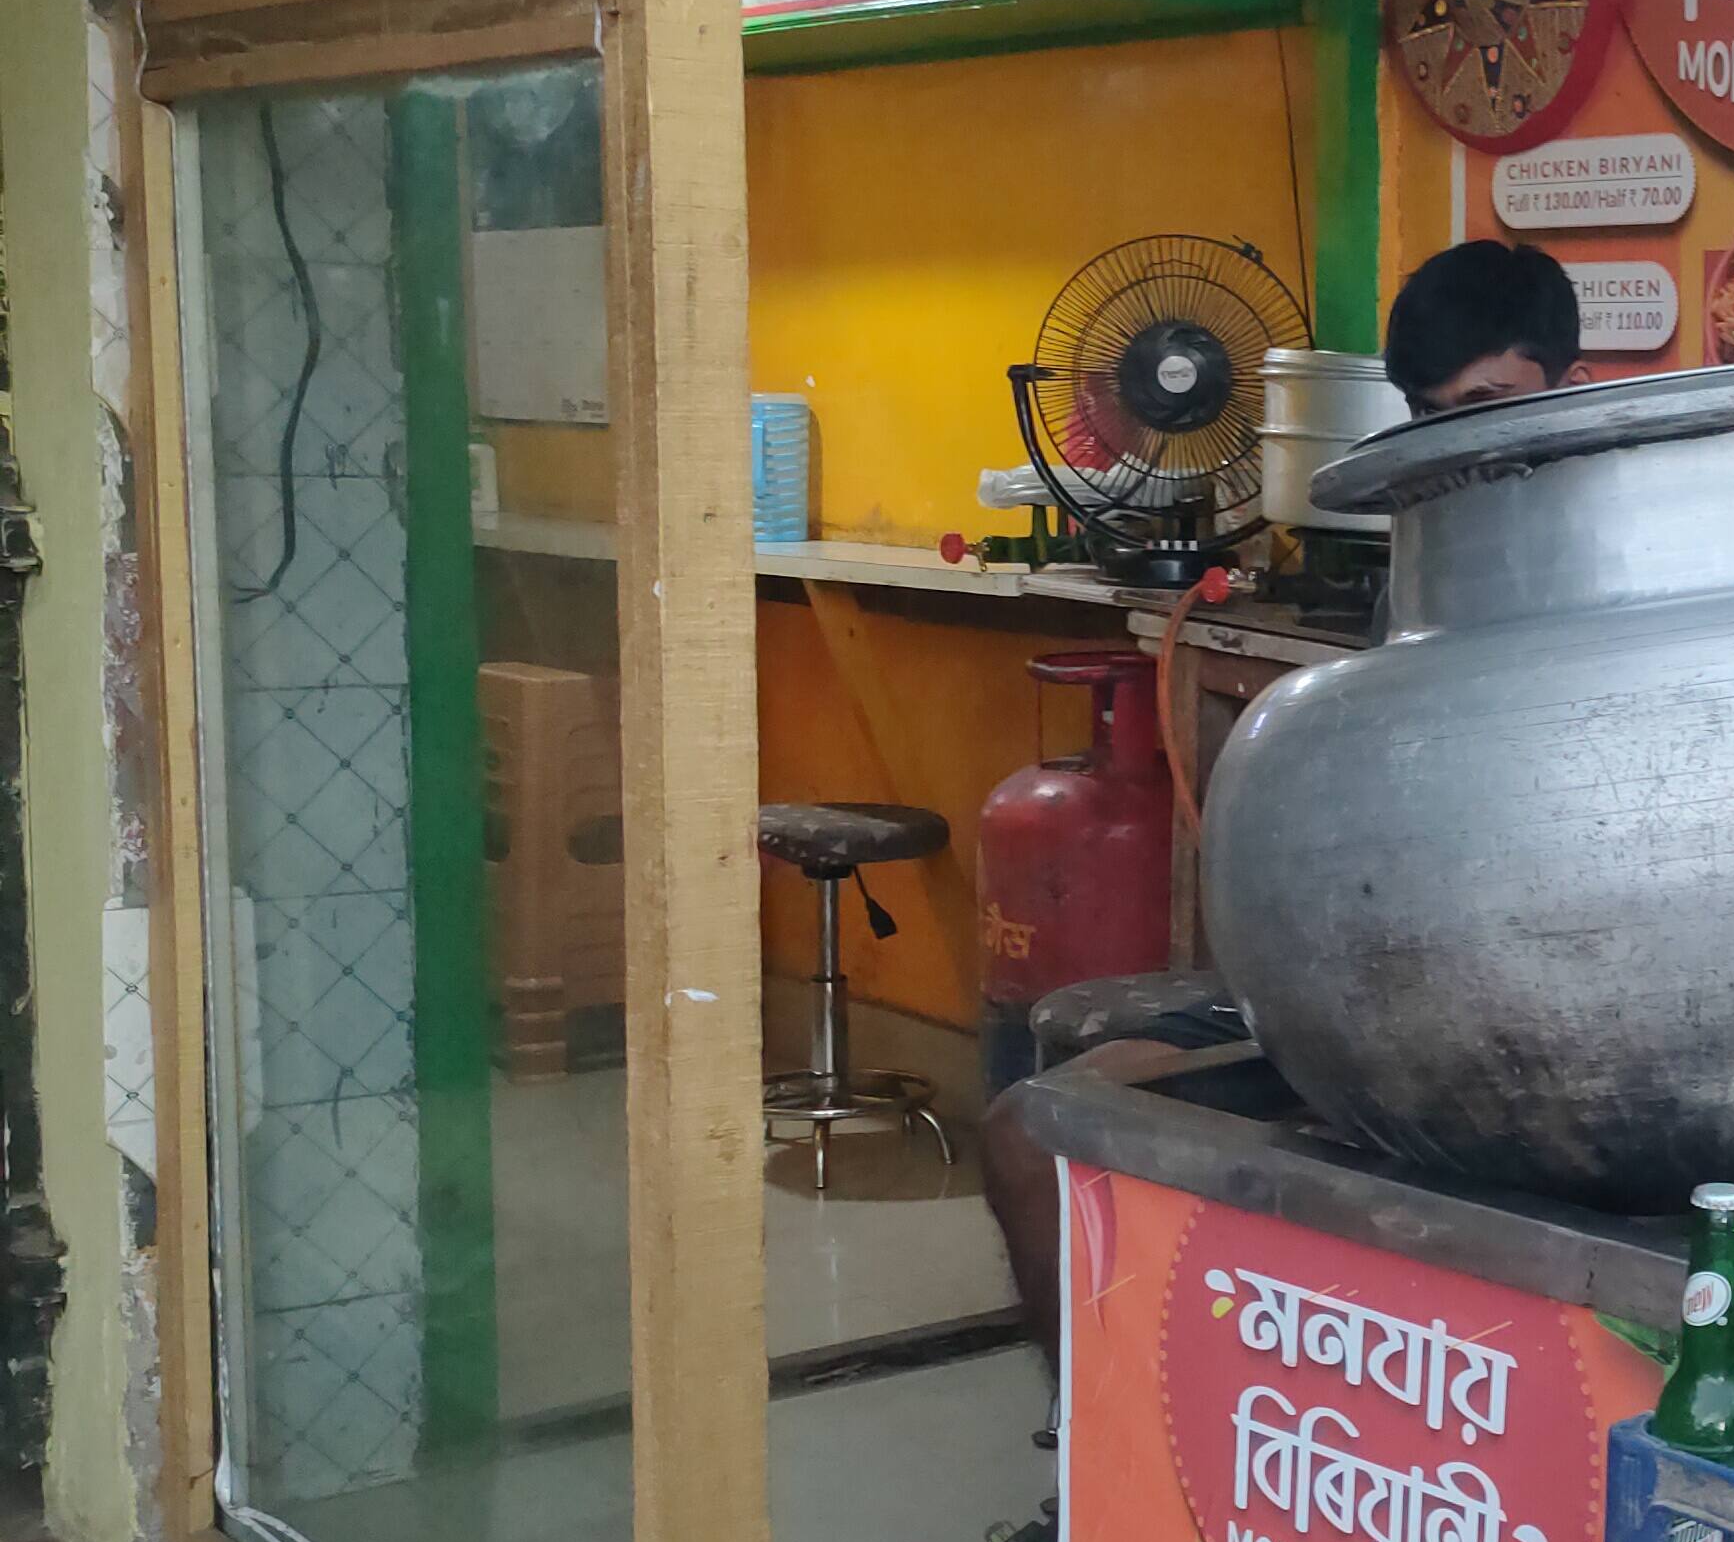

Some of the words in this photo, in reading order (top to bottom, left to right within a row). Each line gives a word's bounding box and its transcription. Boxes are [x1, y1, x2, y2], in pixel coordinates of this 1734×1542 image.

[1507, 159, 1590, 180] CHICKEN
[1599, 154, 1682, 175] BIRYANI
[1507, 194, 1529, 213] Full
[1641, 186, 1683, 206] 70.00
[1617, 311, 1663, 330] 110.00
